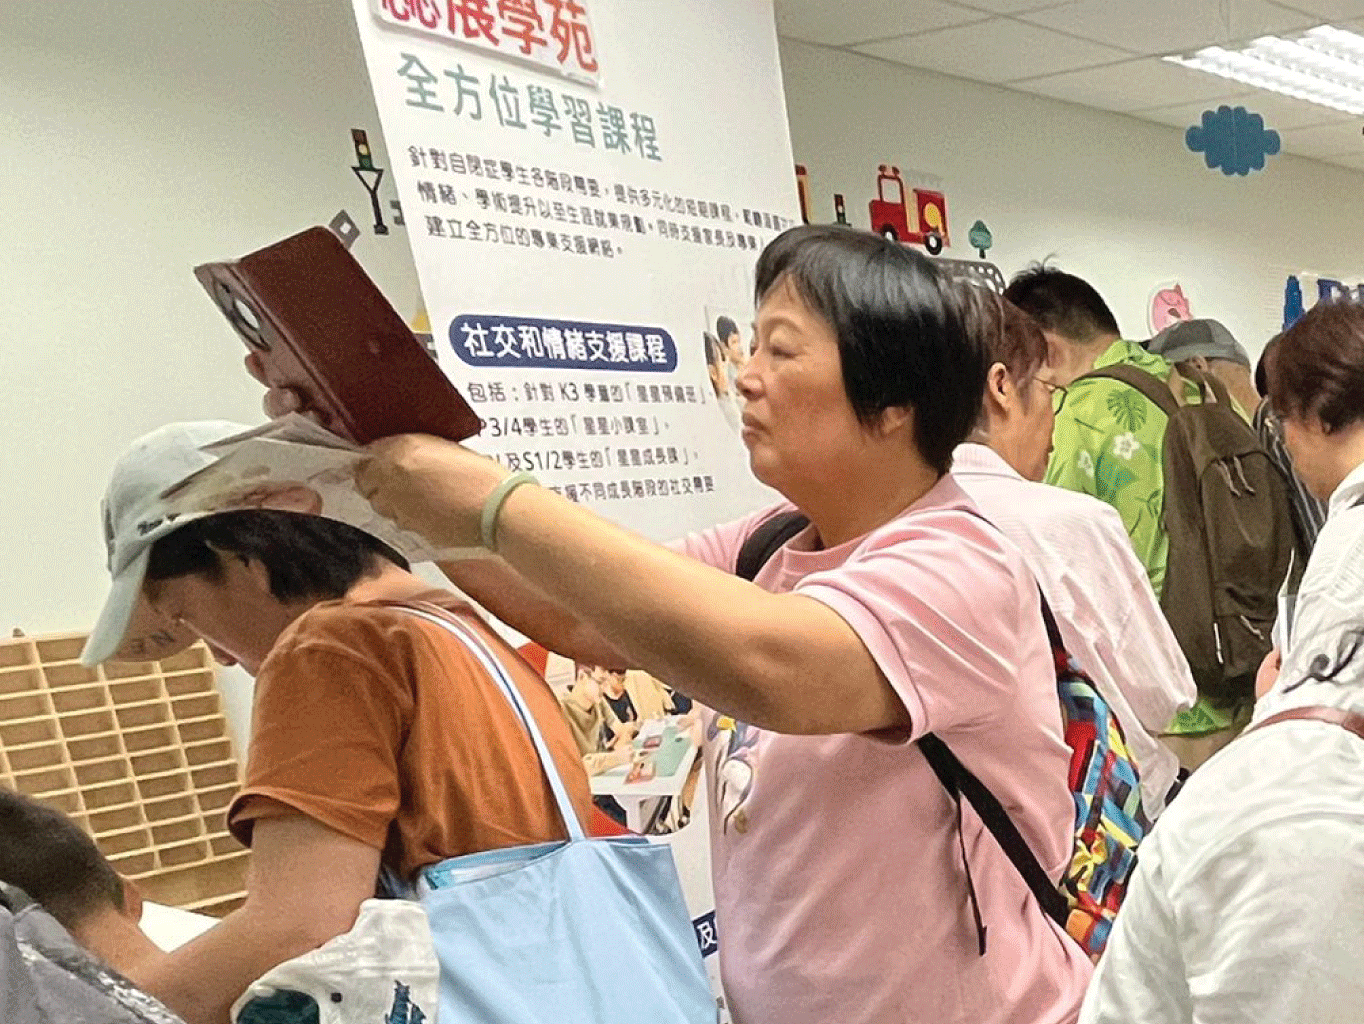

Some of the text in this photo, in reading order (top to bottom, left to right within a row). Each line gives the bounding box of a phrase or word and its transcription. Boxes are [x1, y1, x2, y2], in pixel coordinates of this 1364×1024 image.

[397, 52, 663, 162] 全方位學習課程
[460, 322, 668, 364] 社交和情緒支援課程
[560, 382, 579, 402] K3
